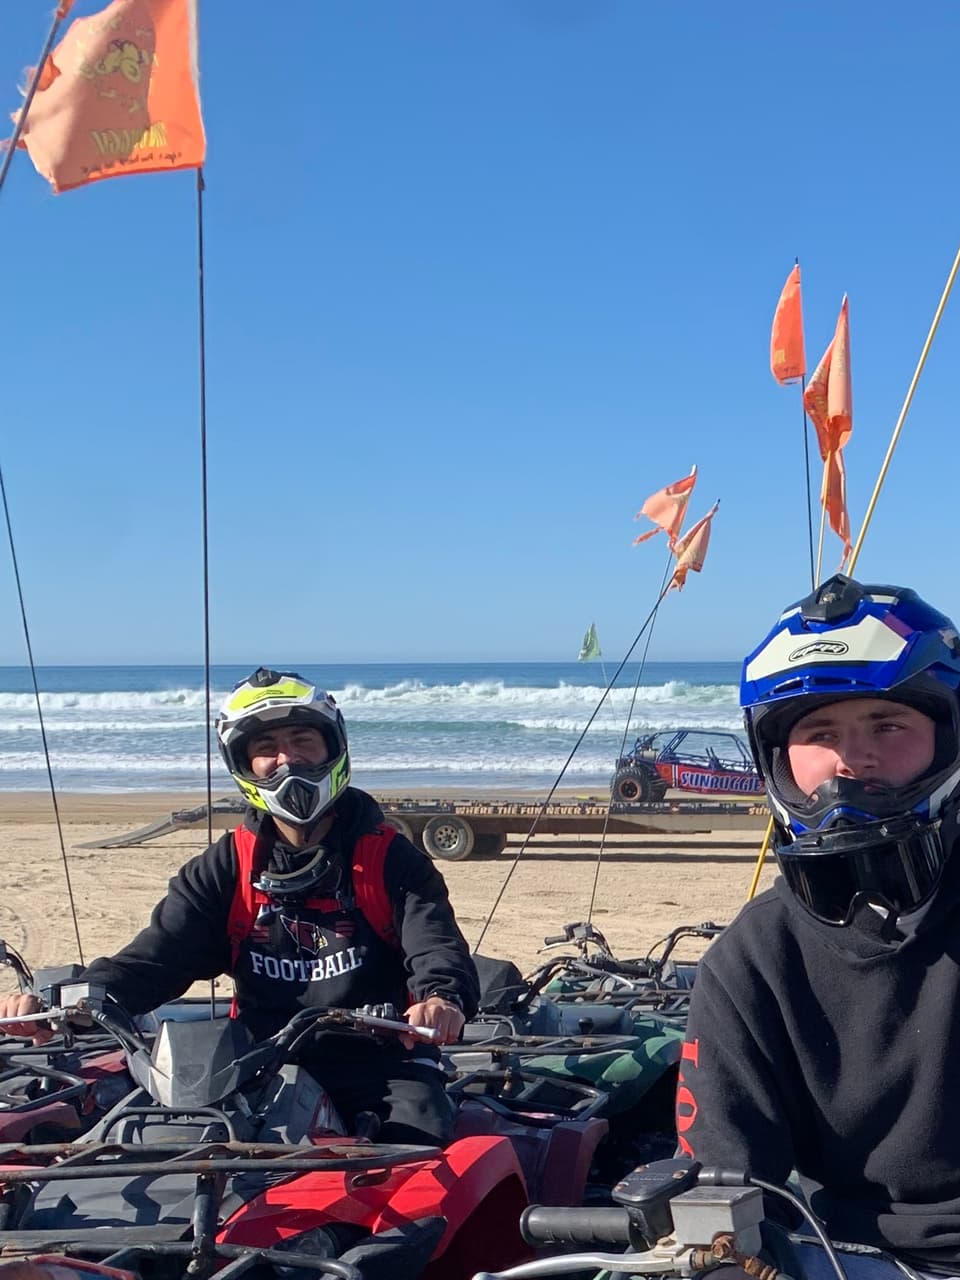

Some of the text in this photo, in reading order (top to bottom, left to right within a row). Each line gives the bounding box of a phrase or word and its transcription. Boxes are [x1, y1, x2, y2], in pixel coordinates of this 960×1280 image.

[455, 806, 609, 815] WHERE THE FUN NEVER SETS
[249, 946, 363, 983] FOOTBALL
